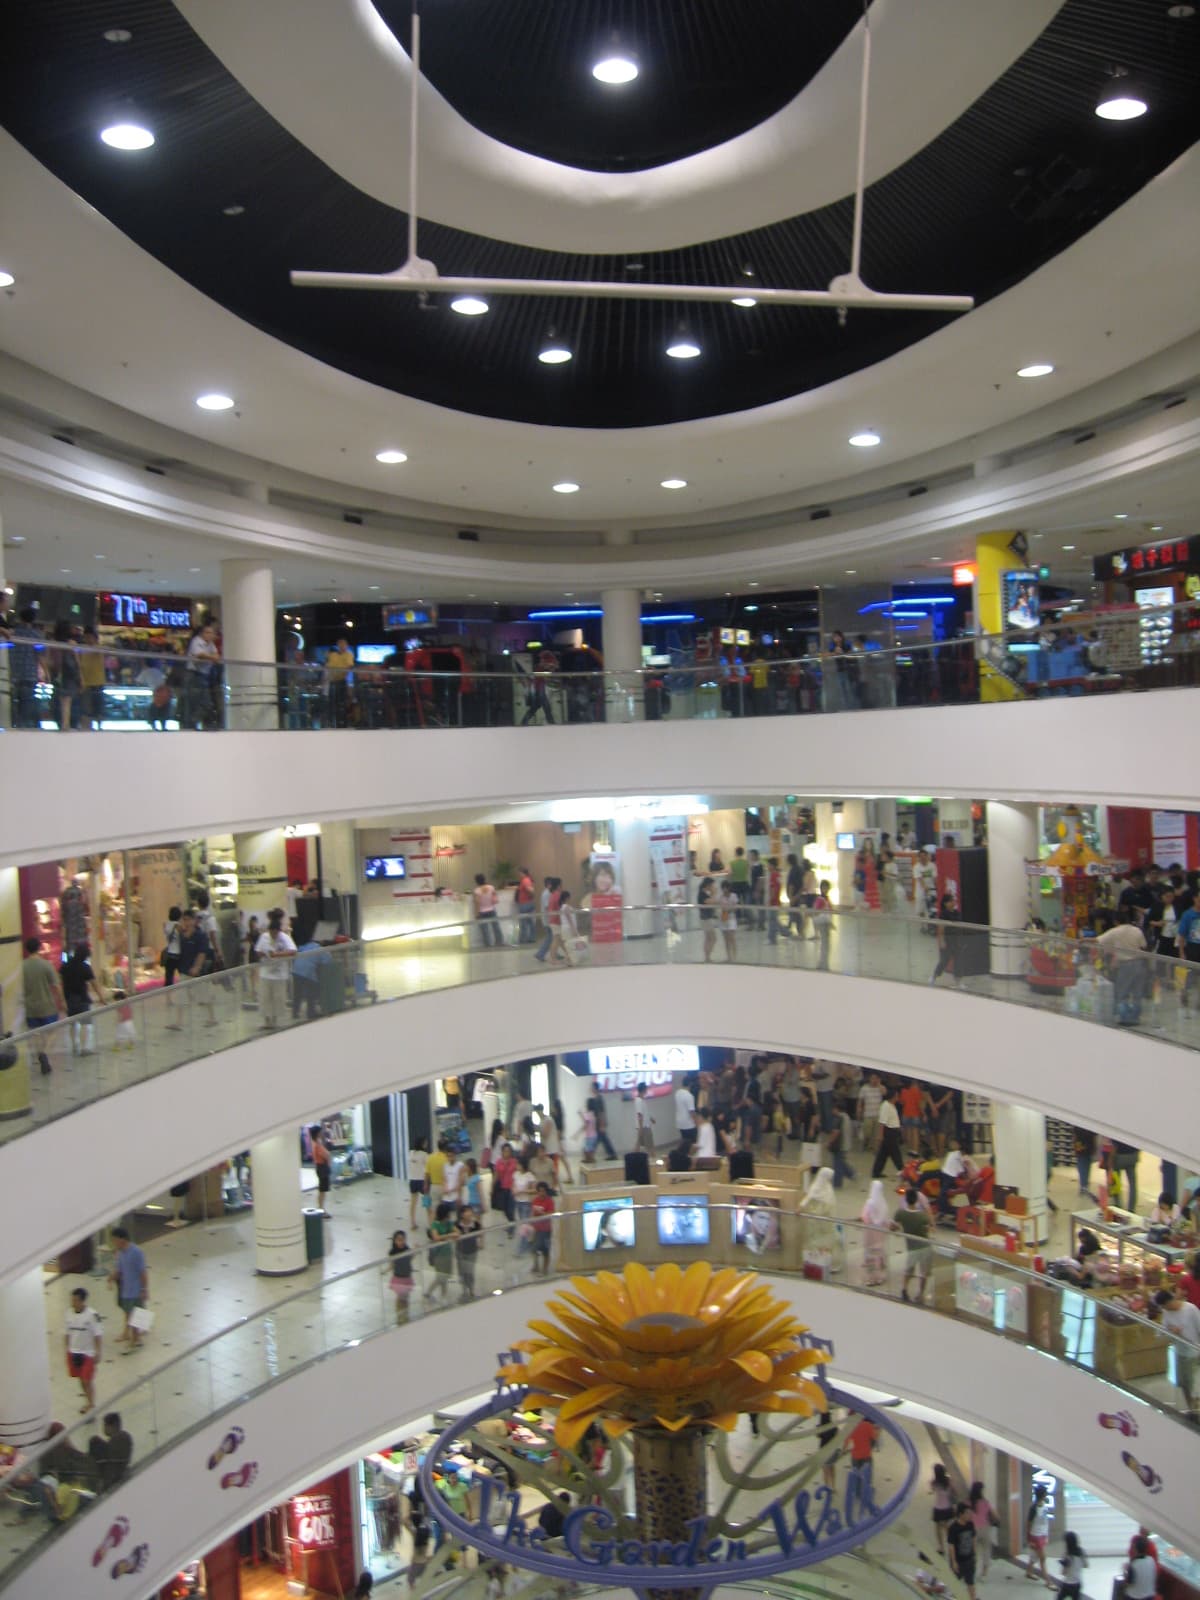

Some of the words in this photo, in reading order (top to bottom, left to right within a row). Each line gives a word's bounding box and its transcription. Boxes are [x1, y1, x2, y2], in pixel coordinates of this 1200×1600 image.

[150, 607, 190, 627] street
[563, 1505, 747, 1568] Garden
[757, 1464, 882, 1558] Walk
